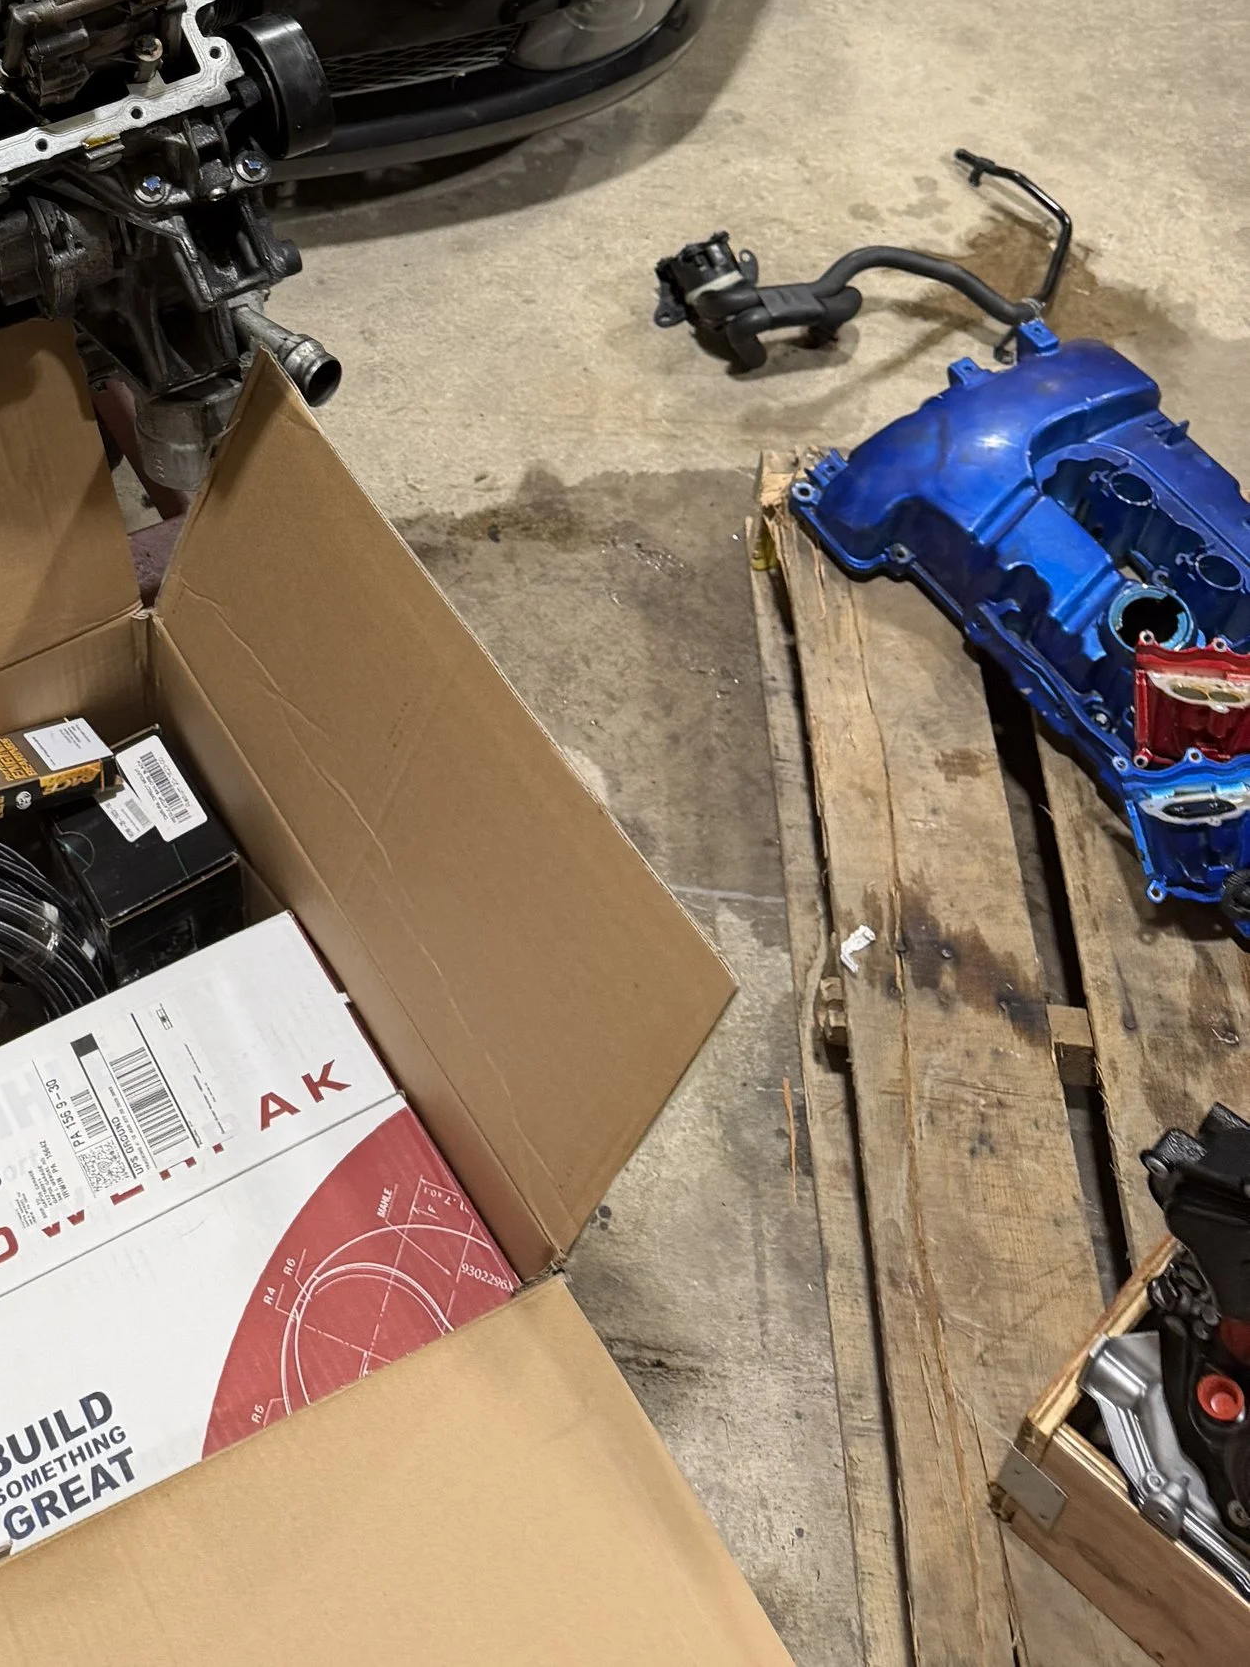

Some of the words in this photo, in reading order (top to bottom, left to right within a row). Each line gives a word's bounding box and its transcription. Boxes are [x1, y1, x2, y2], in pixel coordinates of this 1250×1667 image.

[0, 737, 38, 776] BEARINGS
[59, 1109, 76, 1129] 156
[69, 1130, 85, 1147] PA
[110, 1115, 134, 1154] GROUND
[49, 1162, 58, 1173] PA
[129, 1155, 144, 1175] UPS
[262, 1286, 276, 1306] R4
[3, 1448, 139, 1540] GREAT
